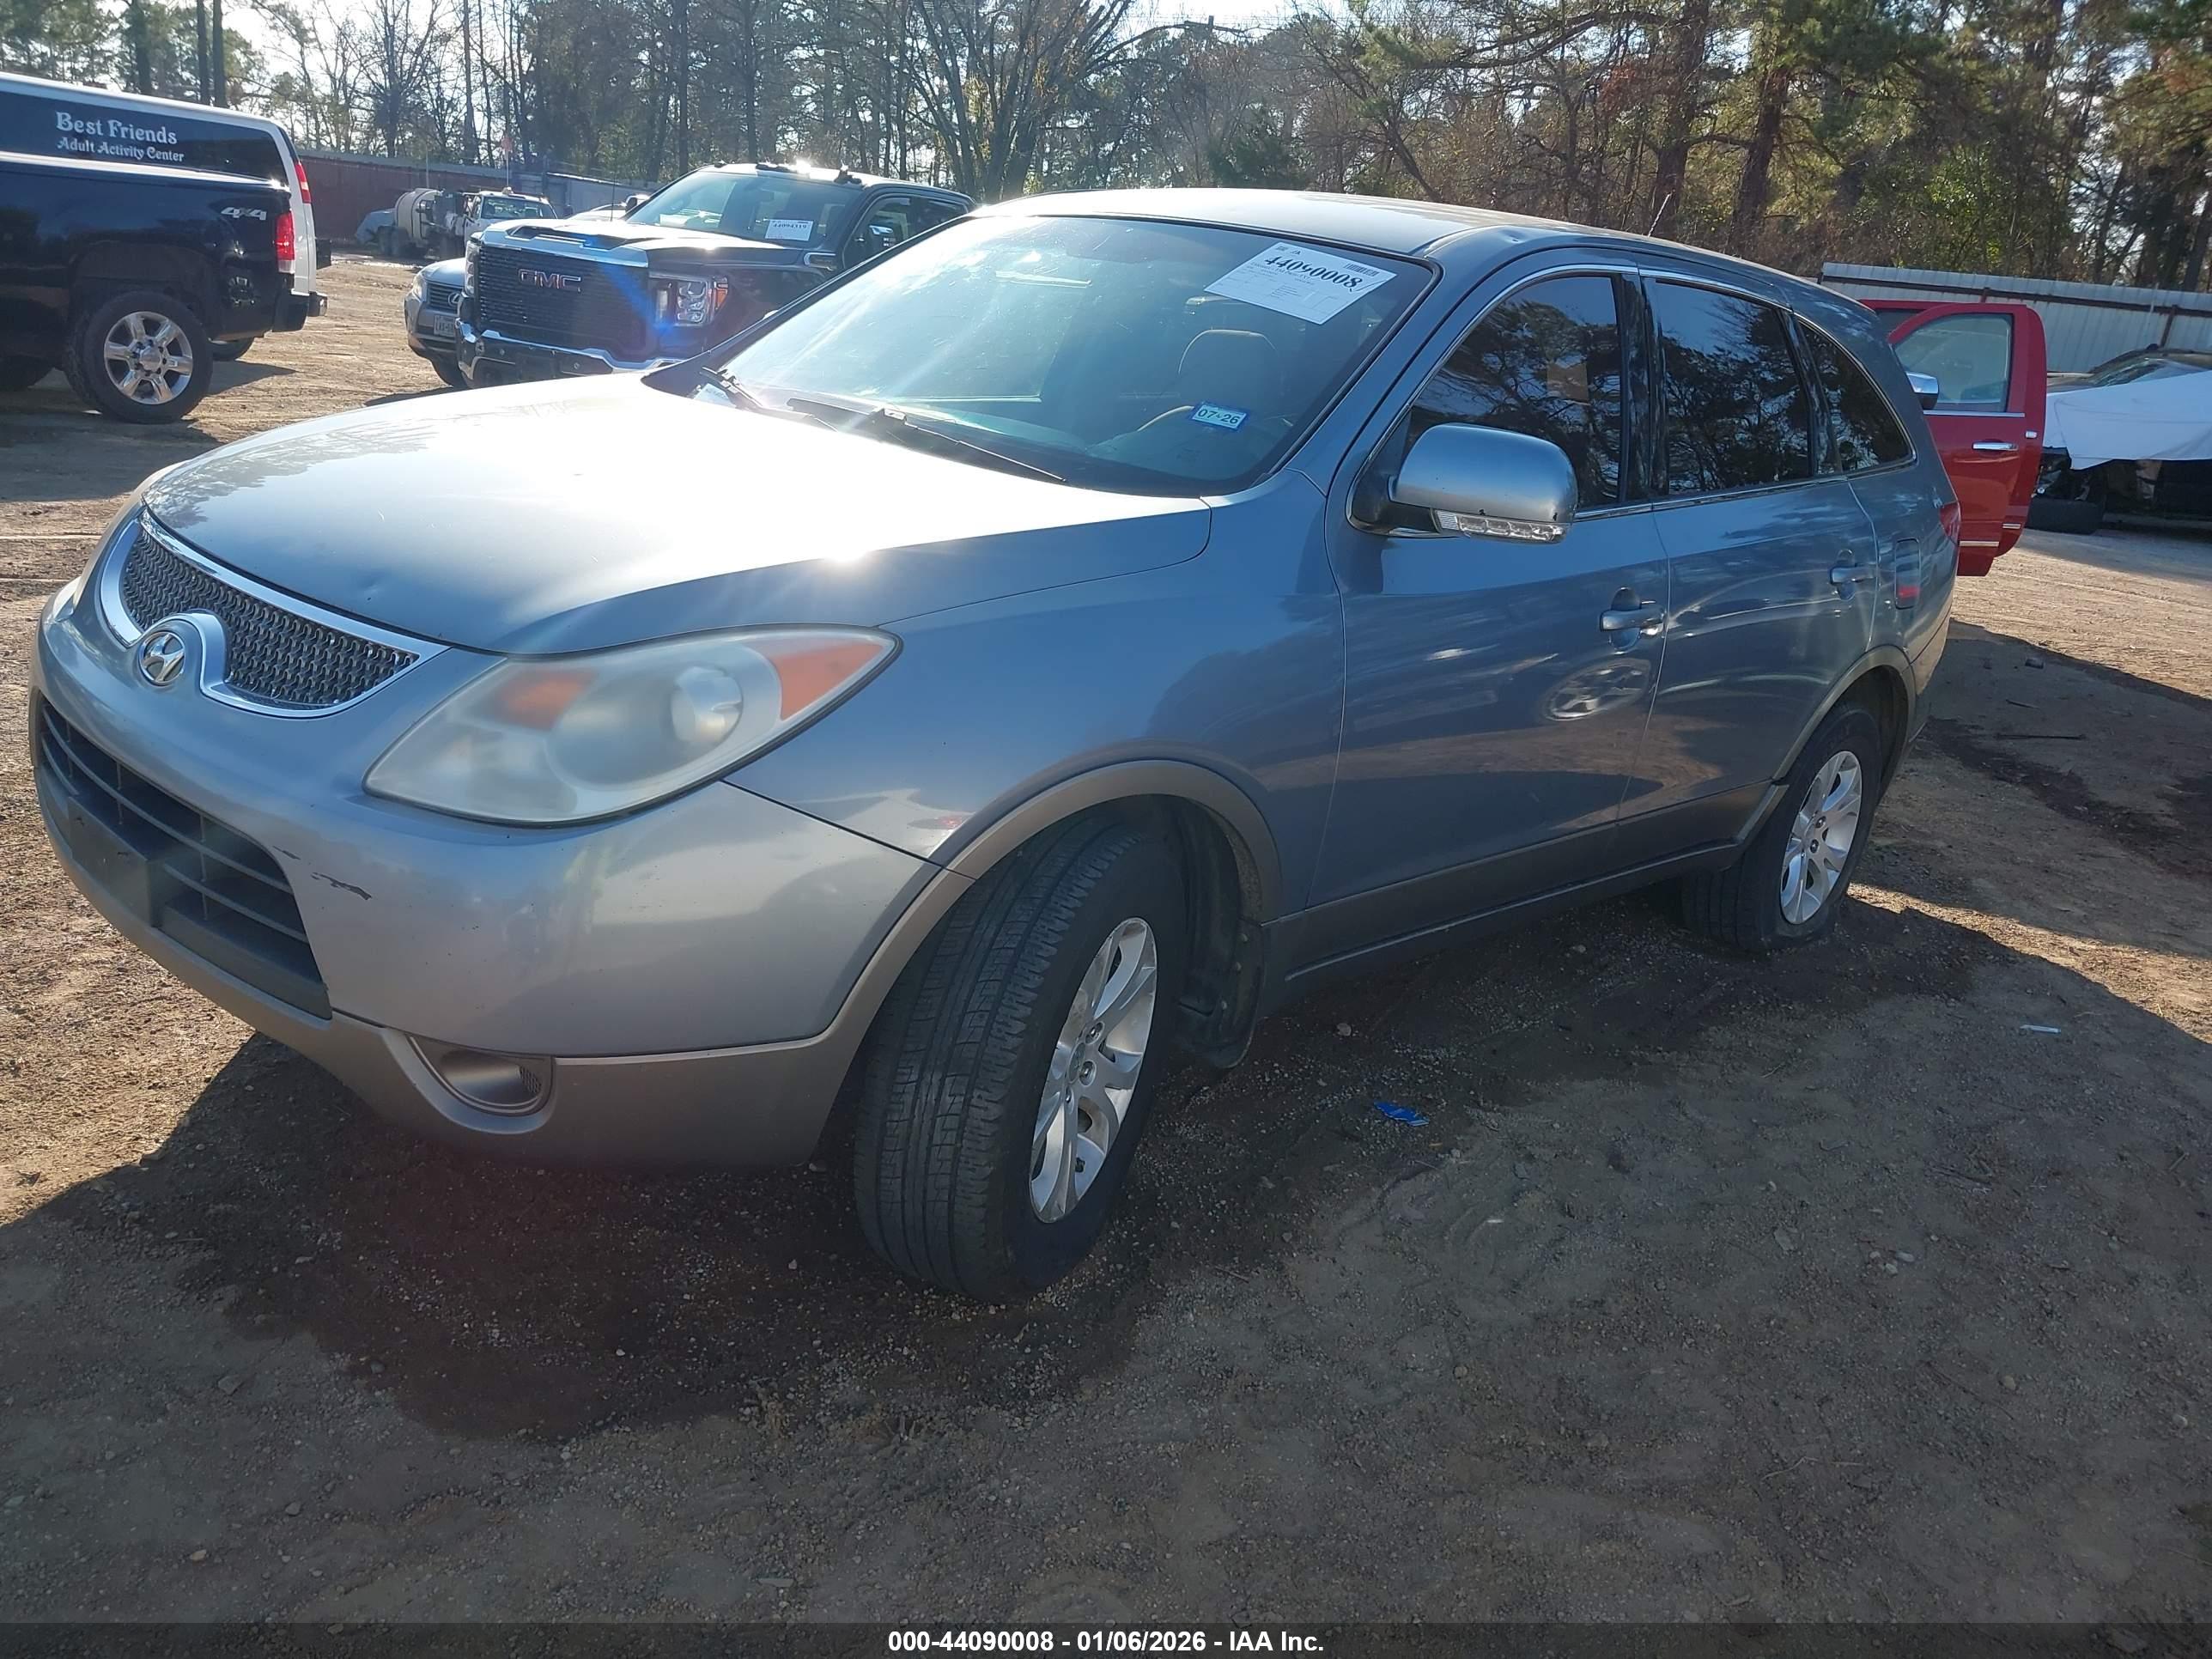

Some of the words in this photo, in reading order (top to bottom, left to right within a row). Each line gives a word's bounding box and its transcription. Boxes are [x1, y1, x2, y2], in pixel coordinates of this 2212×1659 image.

[56, 112, 103, 136] Best
[107, 119, 178, 144] Friends
[57, 137, 95, 153] Adult
[97, 142, 144, 160] Activity
[147, 146, 185, 162] Center
[518, 268, 581, 293] GMC
